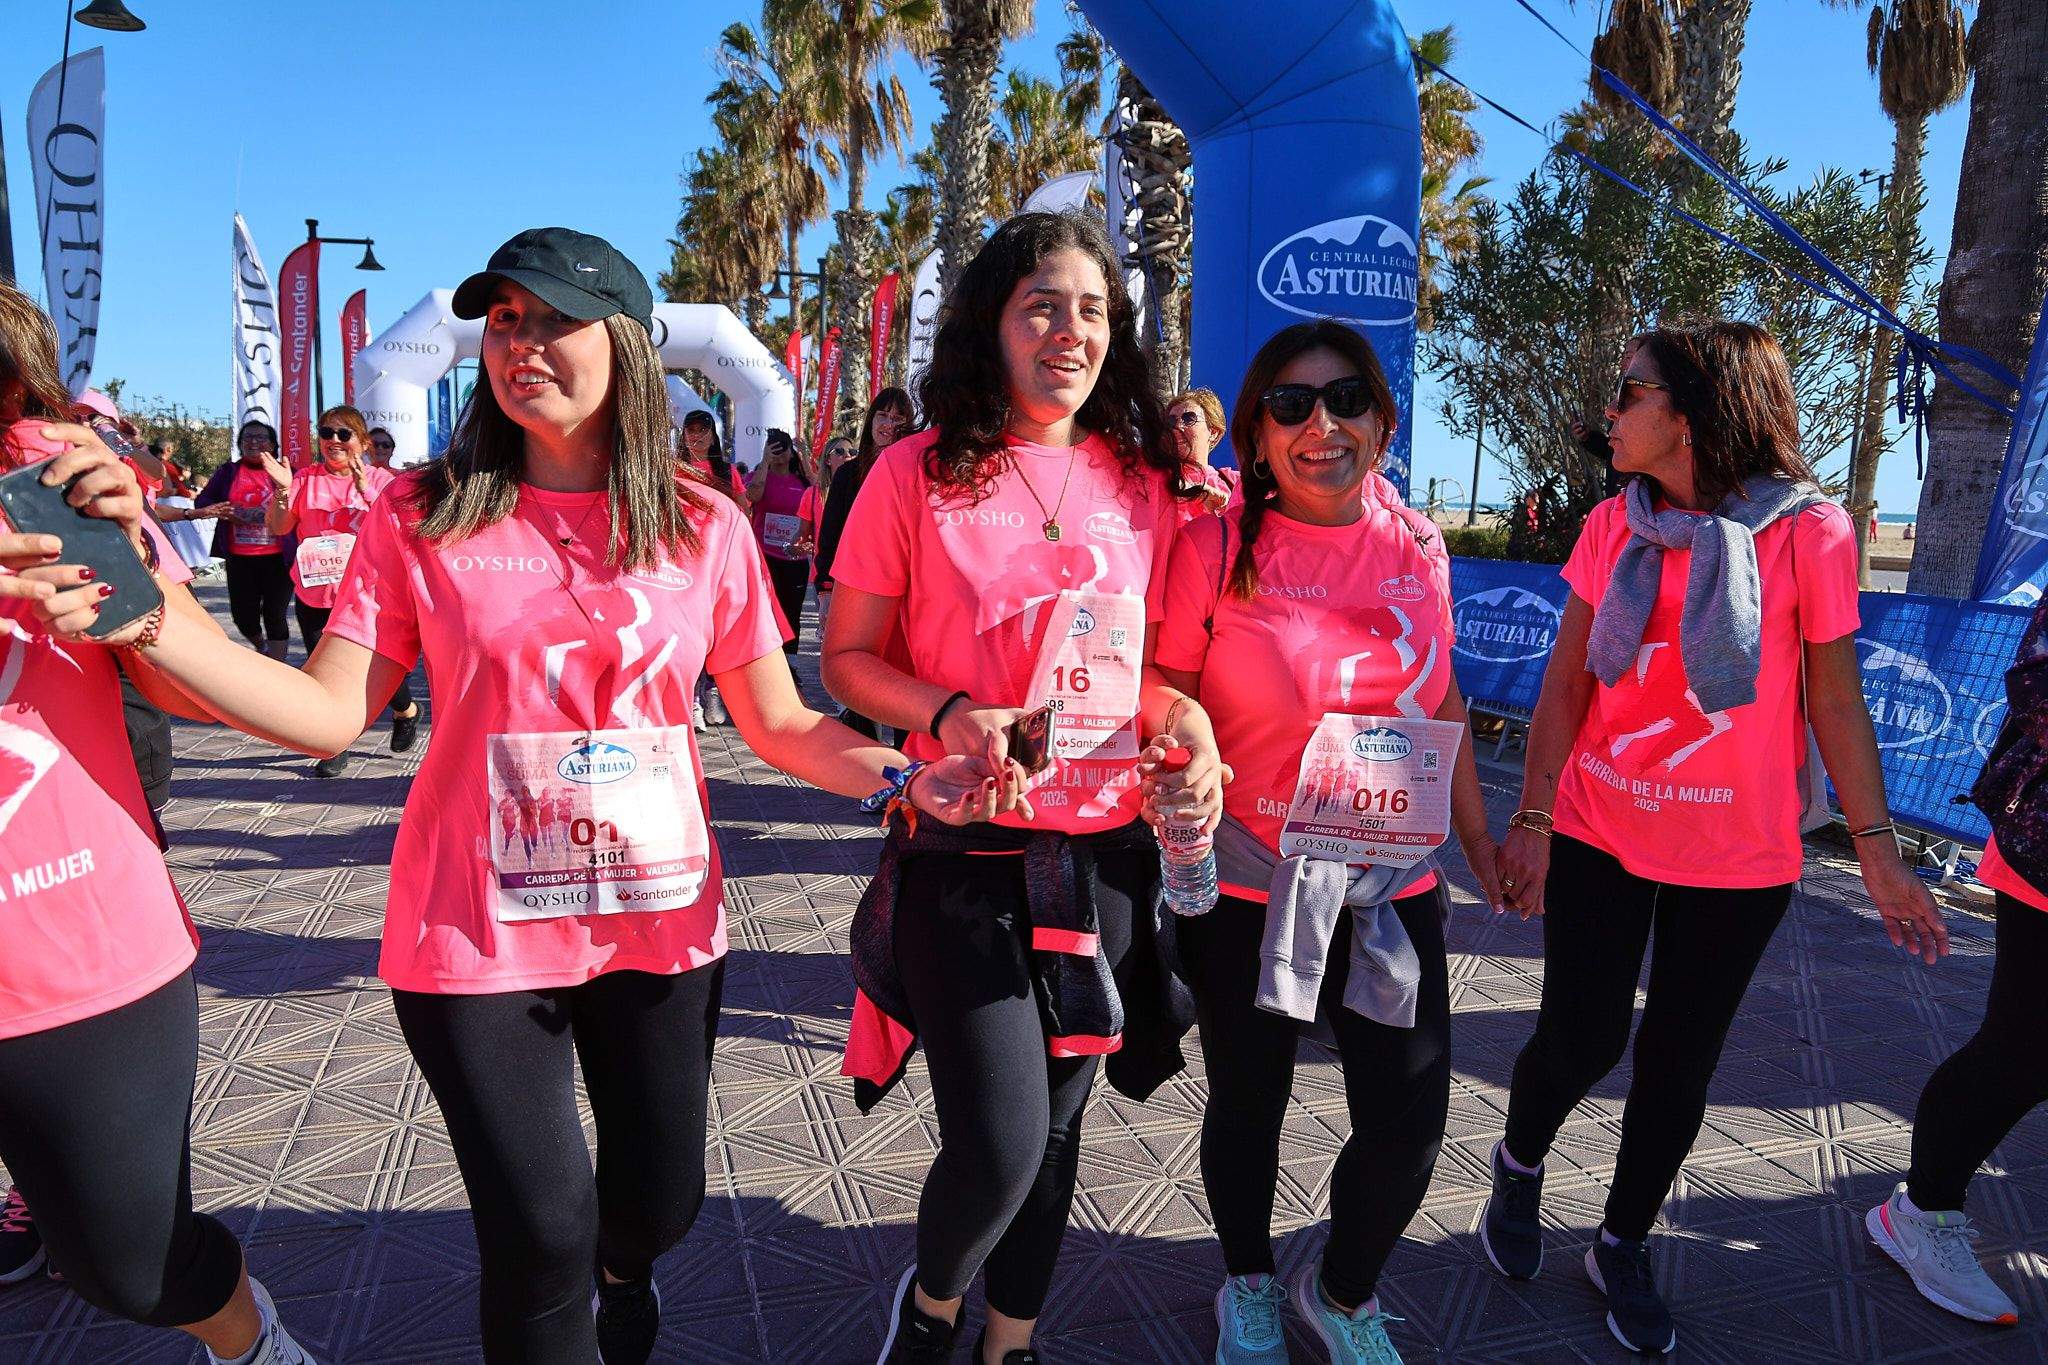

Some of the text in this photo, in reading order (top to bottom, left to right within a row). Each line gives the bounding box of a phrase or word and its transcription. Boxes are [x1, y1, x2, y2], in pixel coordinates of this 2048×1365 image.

[1310, 251, 1377, 264] CENTRAL
[289, 271, 309, 374] Santander
[383, 340, 441, 355] OYSHO
[717, 356, 768, 368] OYSHO
[361, 410, 413, 424] OYSHO
[949, 510, 1025, 528] OYSHO
[321, 556, 343, 567] 016
[452, 556, 548, 574] OYSHO
[636, 568, 688, 586] STURIANA
[1257, 584, 1327, 599] OYSHO
[1052, 665, 1091, 693] 16
[1045, 699, 1065, 712] 98
[1056, 718, 1075, 726] UJER
[1069, 737, 1118, 750] Santander
[1355, 739, 1408, 754] ASTURIANA
[564, 760, 632, 776] ASTURIANA
[1062, 768, 1082, 787] LA
[1086, 768, 1130, 788] MUJER
[1578, 751, 1734, 804] CARRERA DE LA MUJER
[1040, 791, 1068, 807] 2025
[1352, 788, 1409, 814] 016
[1633, 797, 1660, 812] 2025
[569, 817, 619, 846] 01
[1165, 826, 1198, 837] ZERO
[1358, 818, 1386, 830] 1501
[1304, 824, 1428, 844] CARRERA DE LA MUJER VALENCIA
[1295, 837, 1424, 861] OYSHO Santander
[588, 851, 626, 866] 4101
[12, 848, 95, 898] MUJER
[525, 862, 687, 885] CARRERA DE LA MUJER VALENCIA
[523, 884, 692, 908] OYSHO Santander
